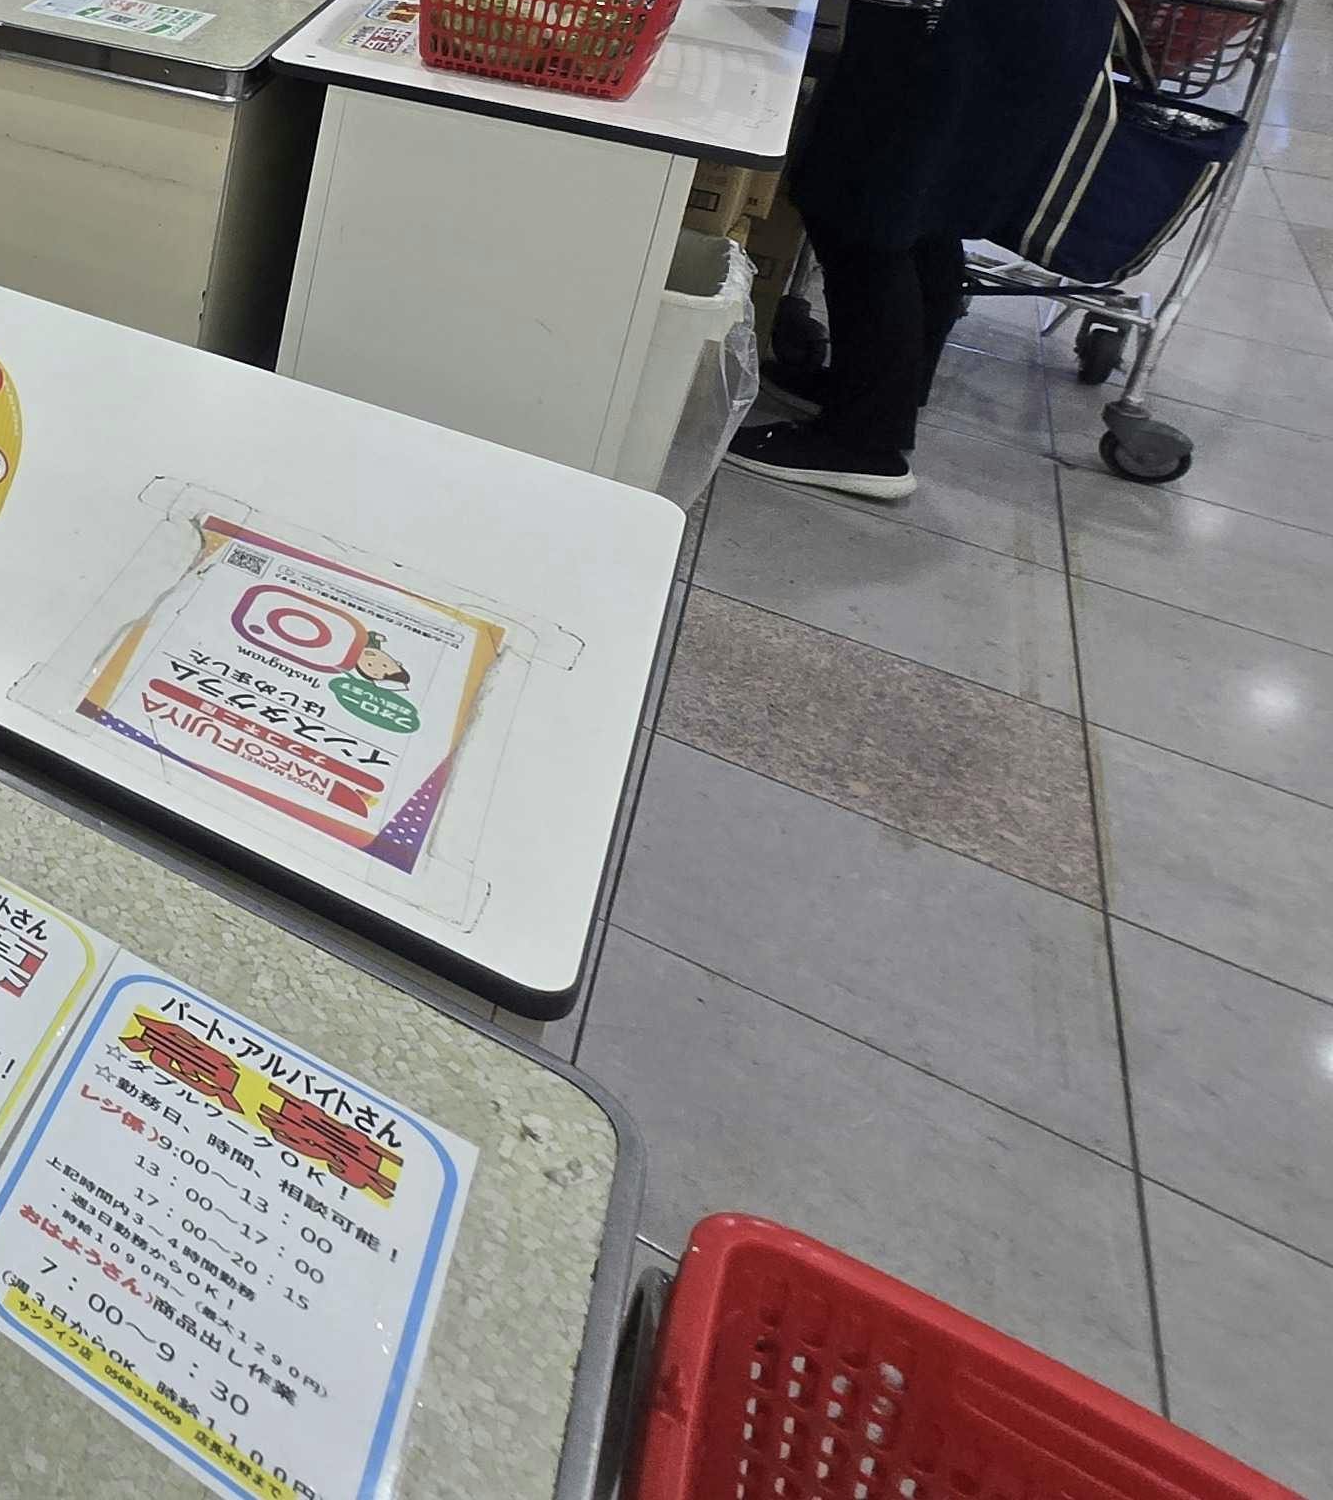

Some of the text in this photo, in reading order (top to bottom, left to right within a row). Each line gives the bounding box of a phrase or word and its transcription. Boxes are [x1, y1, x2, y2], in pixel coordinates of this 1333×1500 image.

[171, 660, 391, 767] インスタグラム
[188, 648, 326, 718] はじめました
[236, 645, 321, 689] Instagram
[341, 694, 412, 730] フォロー
[118, 1012, 404, 1202] 急募
[160, 997, 403, 1149] パート・アルバイトさん
[18, 1300, 92, 1361] サンライフ店
[104, 1364, 182, 1425] 0568-31-6009
